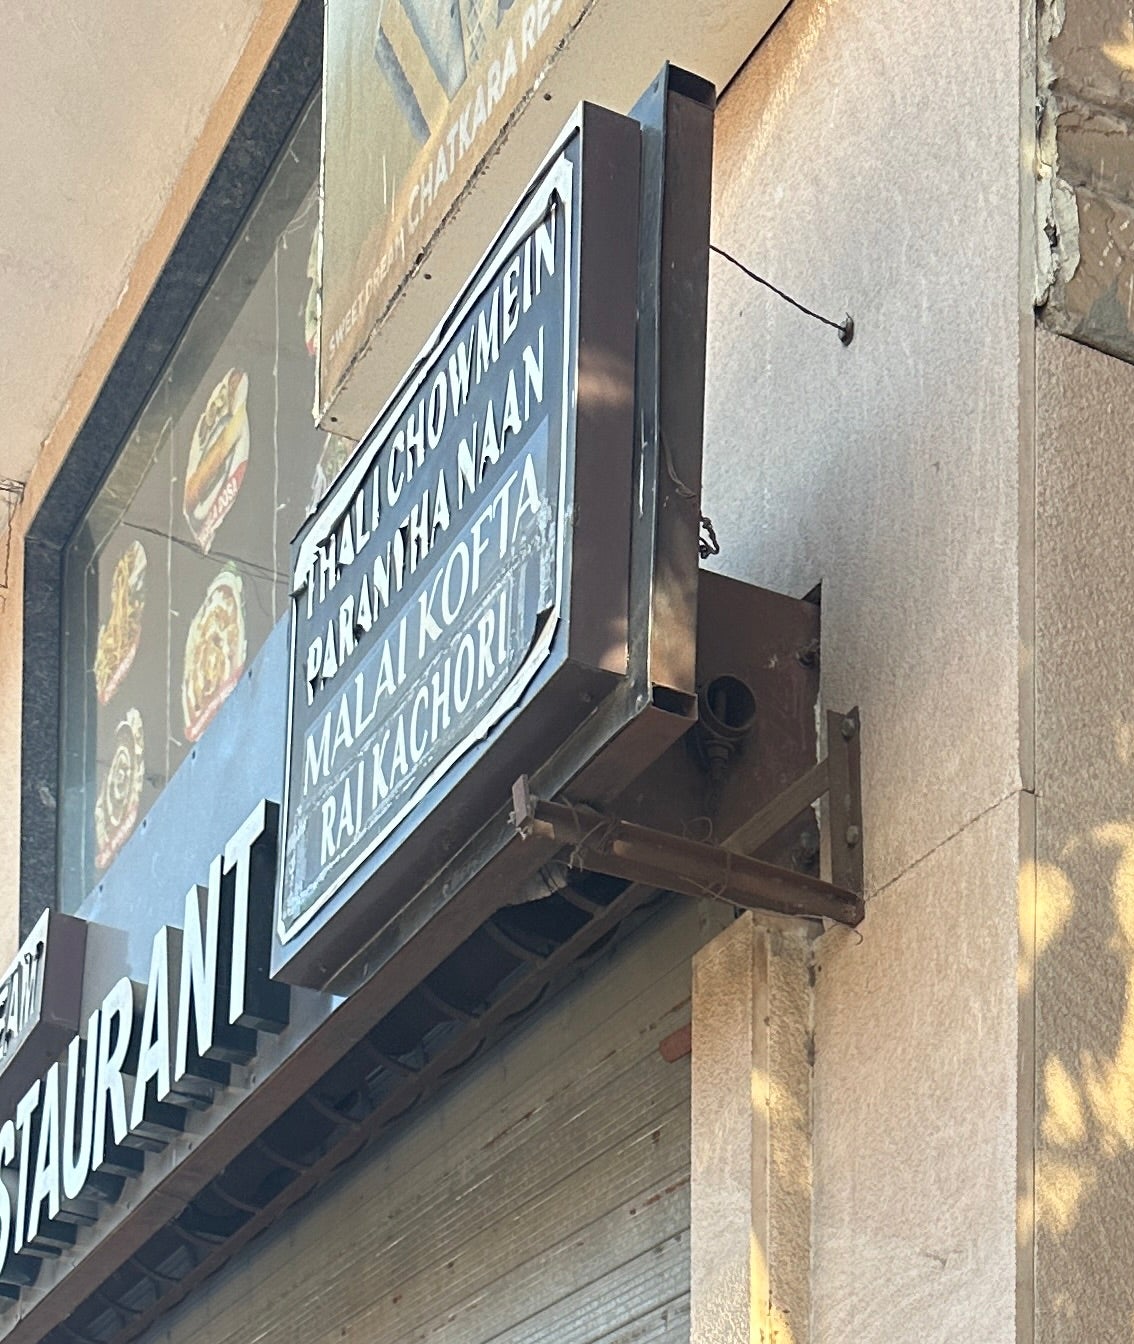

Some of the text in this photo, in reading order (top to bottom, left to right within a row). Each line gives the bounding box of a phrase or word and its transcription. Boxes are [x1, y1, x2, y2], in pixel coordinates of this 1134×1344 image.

[408, 35, 519, 236] CHATKARA
[521, 0, 563, 65] RE
[305, 204, 556, 620] THALI CHOWMEIN
[458, 325, 544, 510] NAAN
[303, 453, 541, 795] MALAI KOFTA
[371, 590, 508, 811] KACHORI
